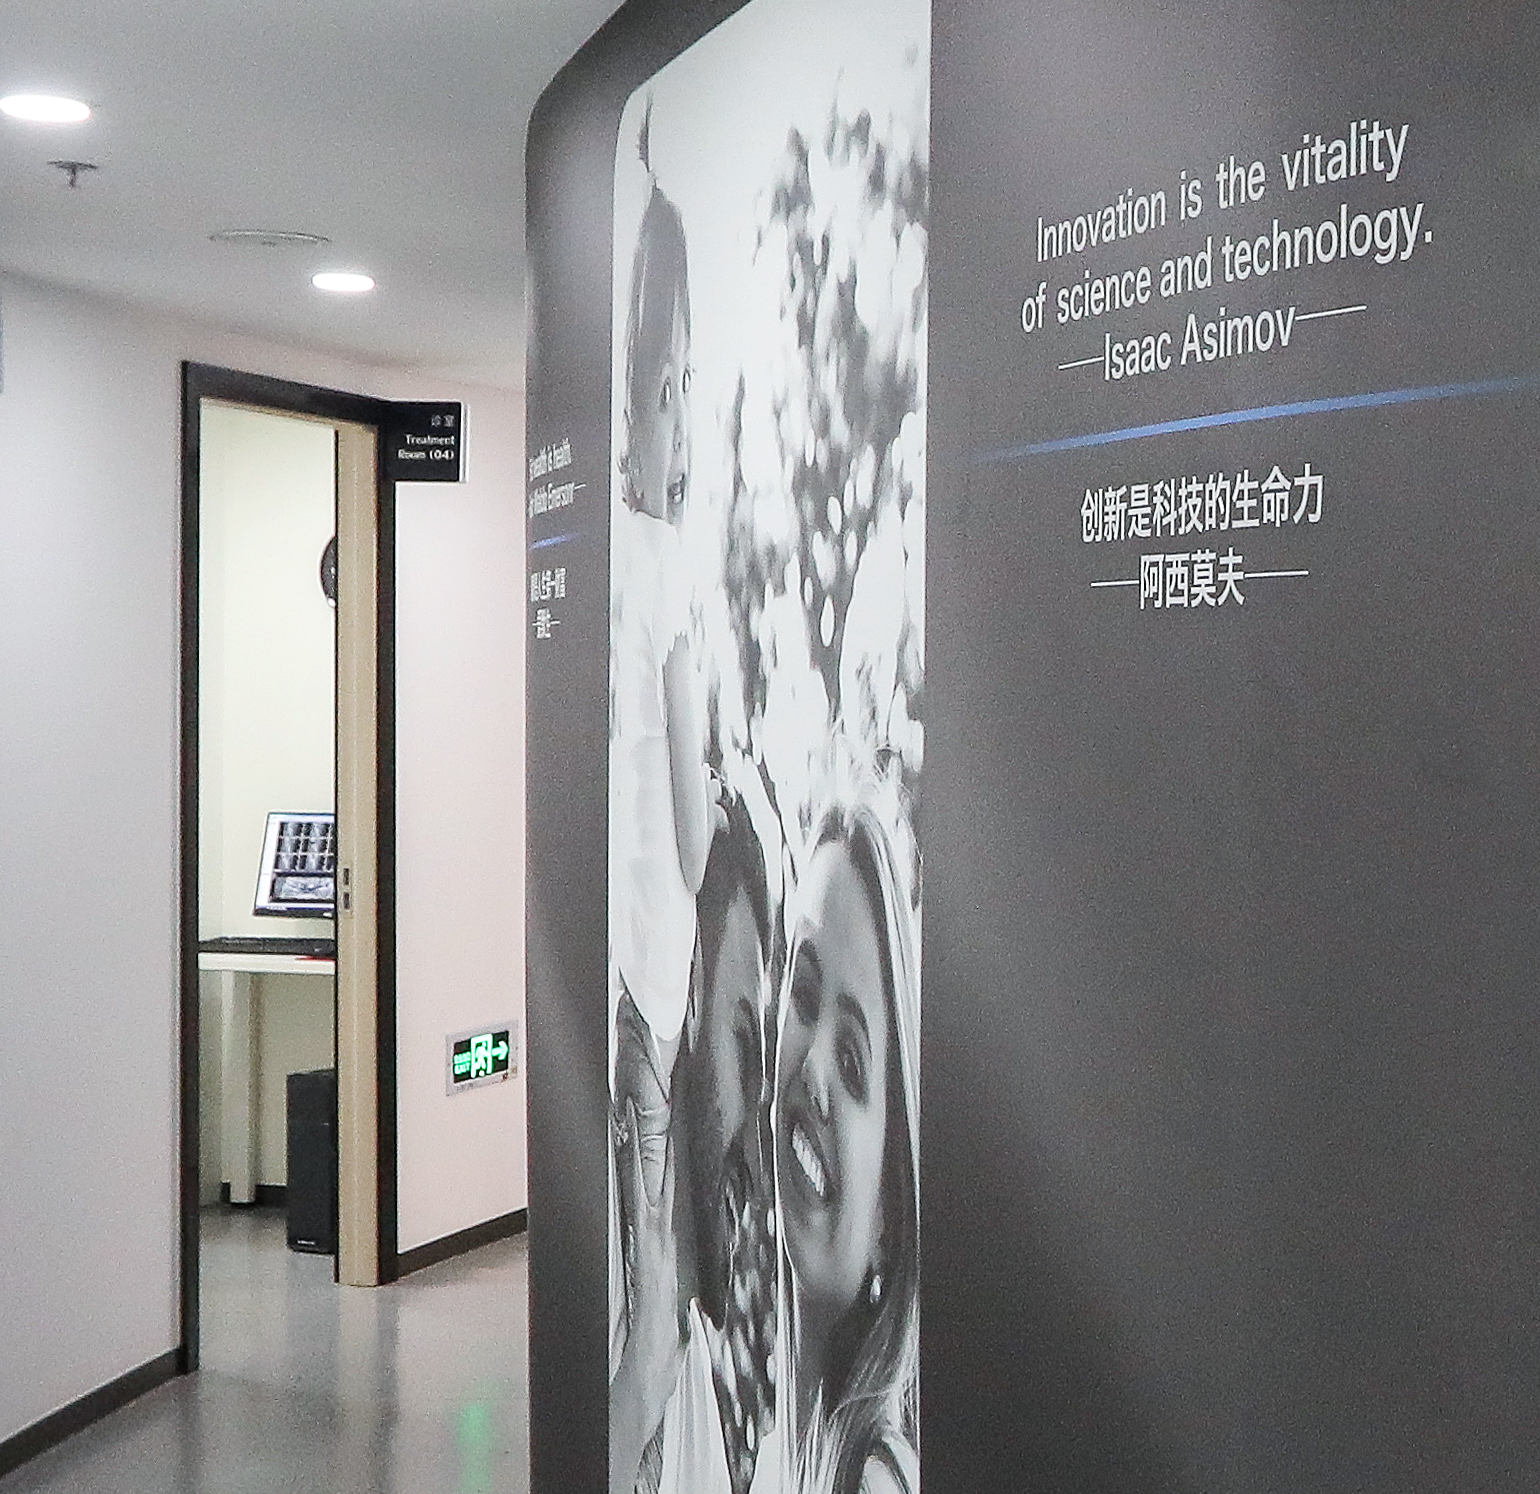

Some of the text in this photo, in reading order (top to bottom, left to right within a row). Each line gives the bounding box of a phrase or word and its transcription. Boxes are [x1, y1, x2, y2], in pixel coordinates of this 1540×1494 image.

[1036, 119, 1409, 263] Innovation is the vitality
[1020, 203, 1434, 333] of science and technology.
[1080, 463, 1325, 544] 创新是科技的生命力
